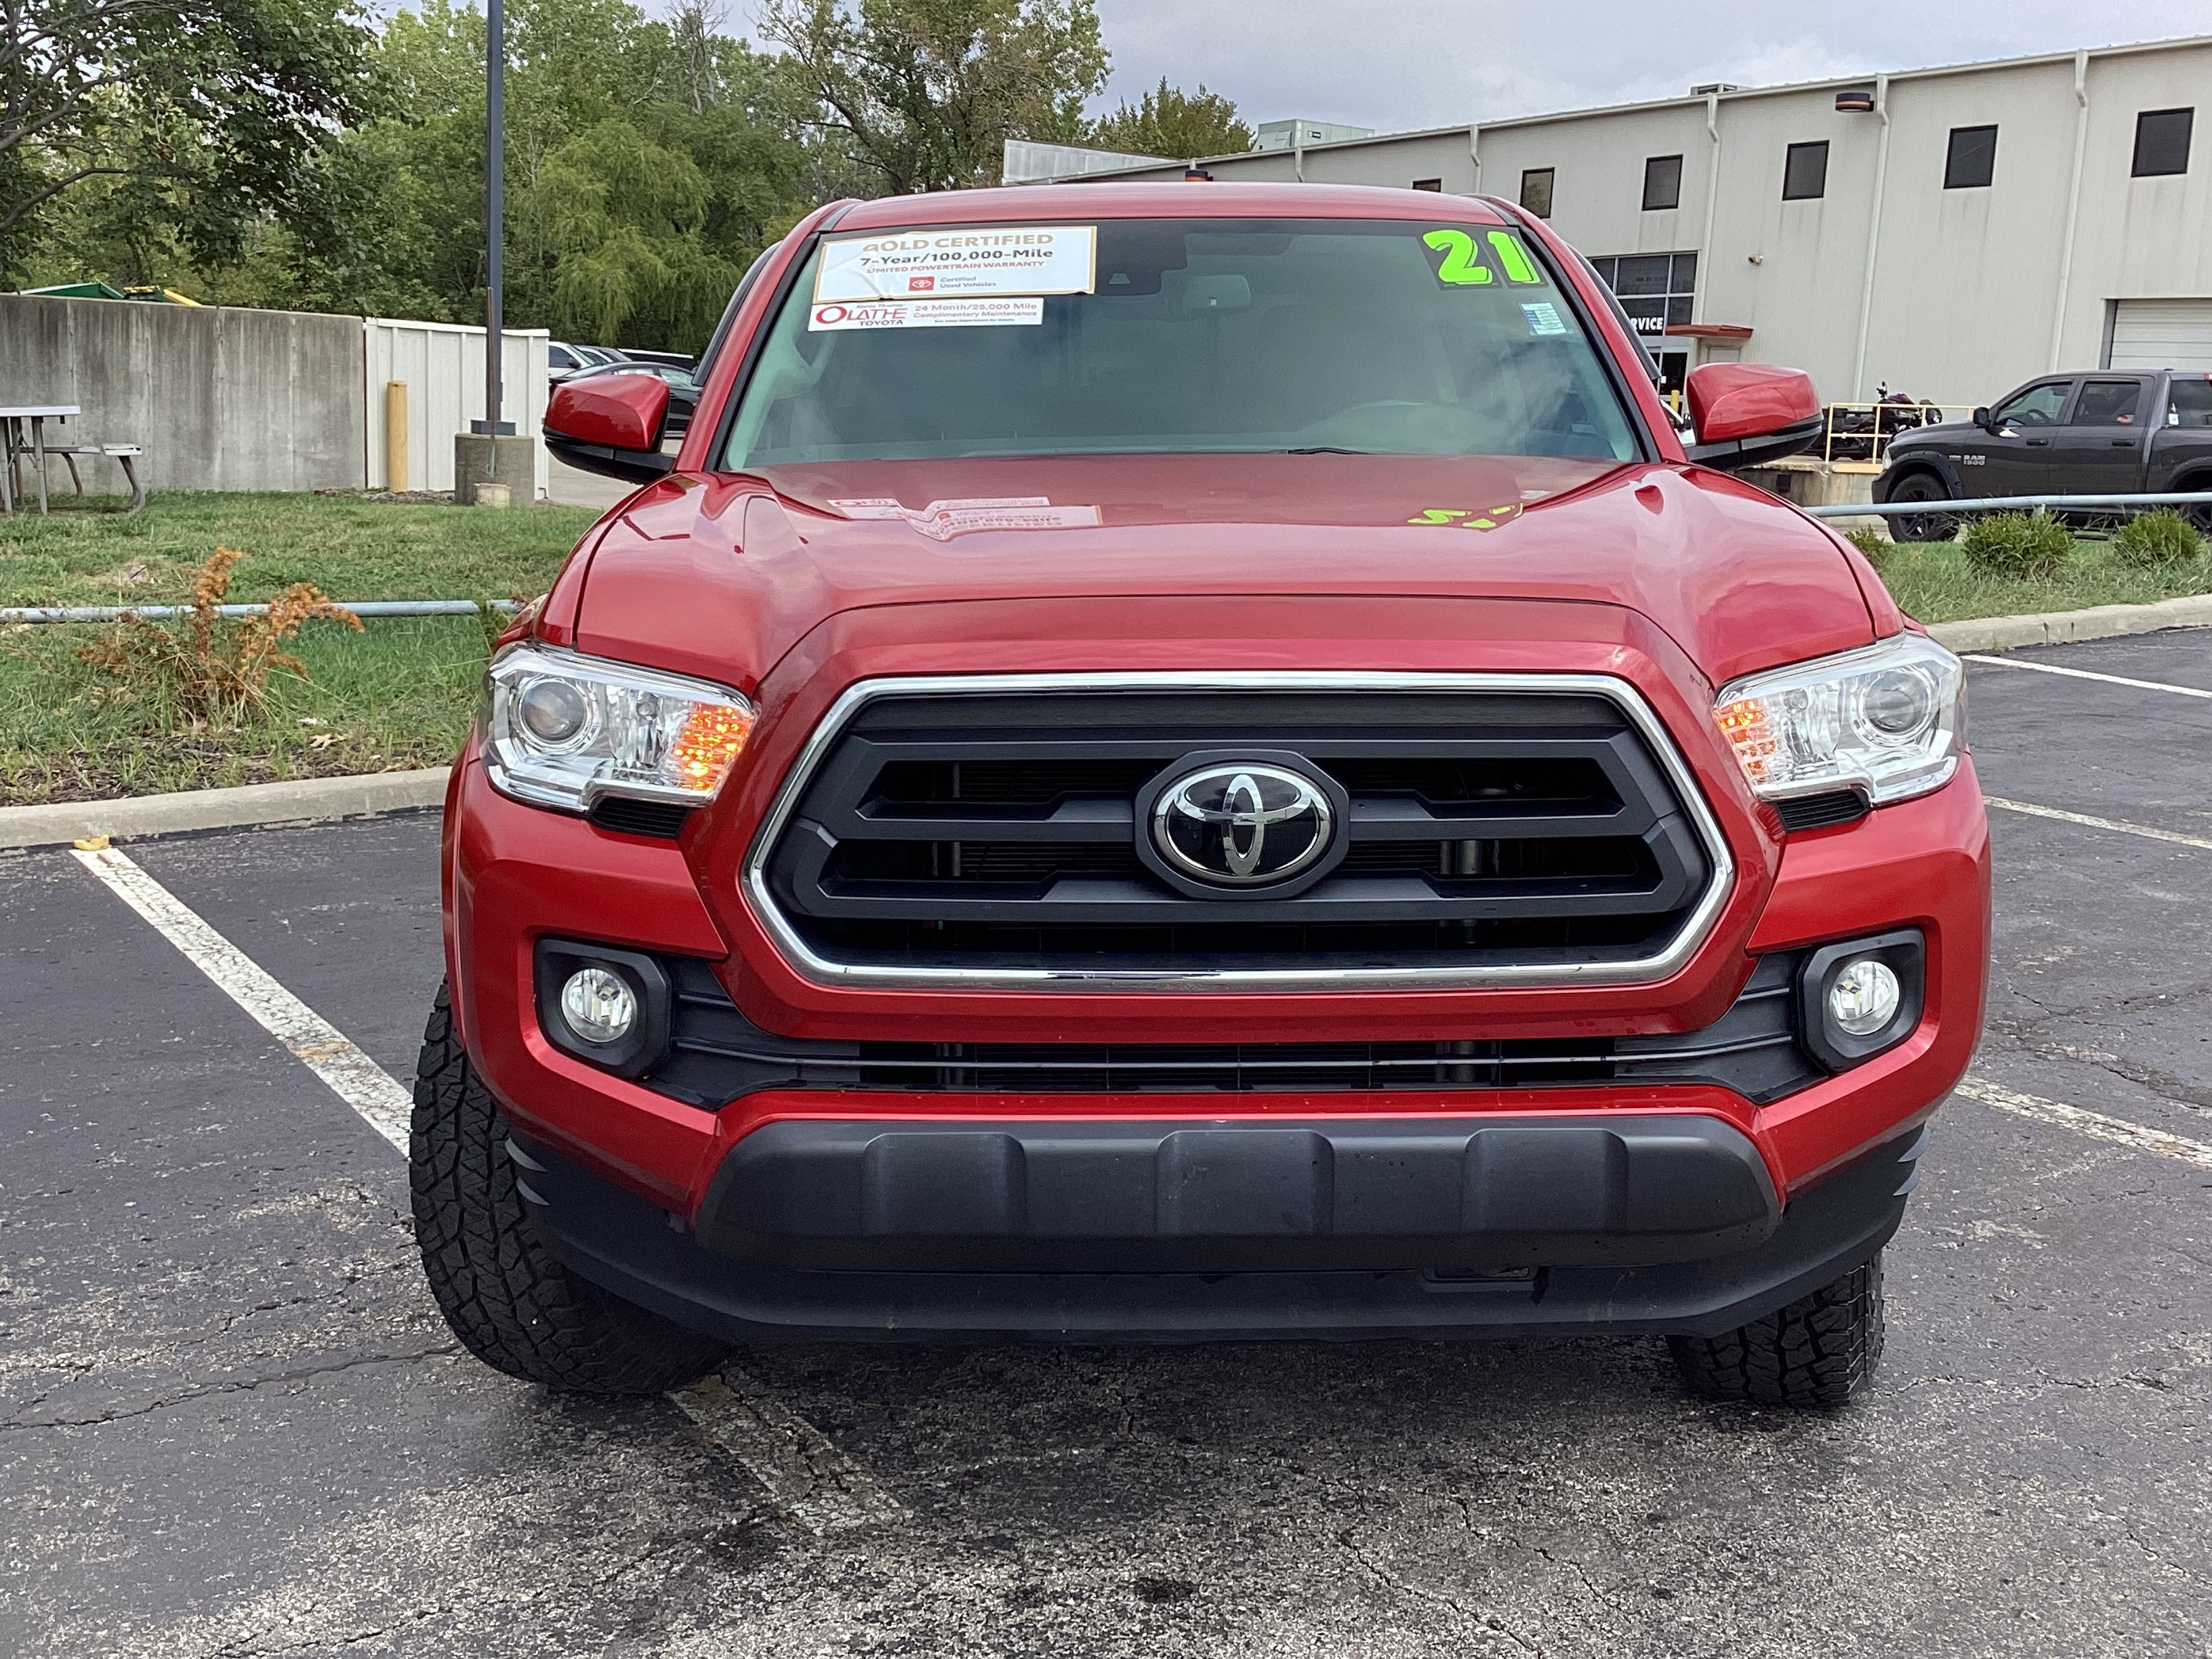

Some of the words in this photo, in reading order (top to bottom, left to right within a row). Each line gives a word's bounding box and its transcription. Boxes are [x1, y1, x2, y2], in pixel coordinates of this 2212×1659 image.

[935, 234, 1054, 248] CERTIFIED
[860, 248, 1054, 266] 7-Year/100,000-Mile
[1423, 229, 1541, 285] 21
[867, 265, 909, 274] LIMITED
[910, 262, 981, 272] POWERTRAIN
[983, 260, 1045, 269] WARRANTY
[815, 306, 908, 324] OLATHE
[1631, 316, 1664, 331] RVICE
